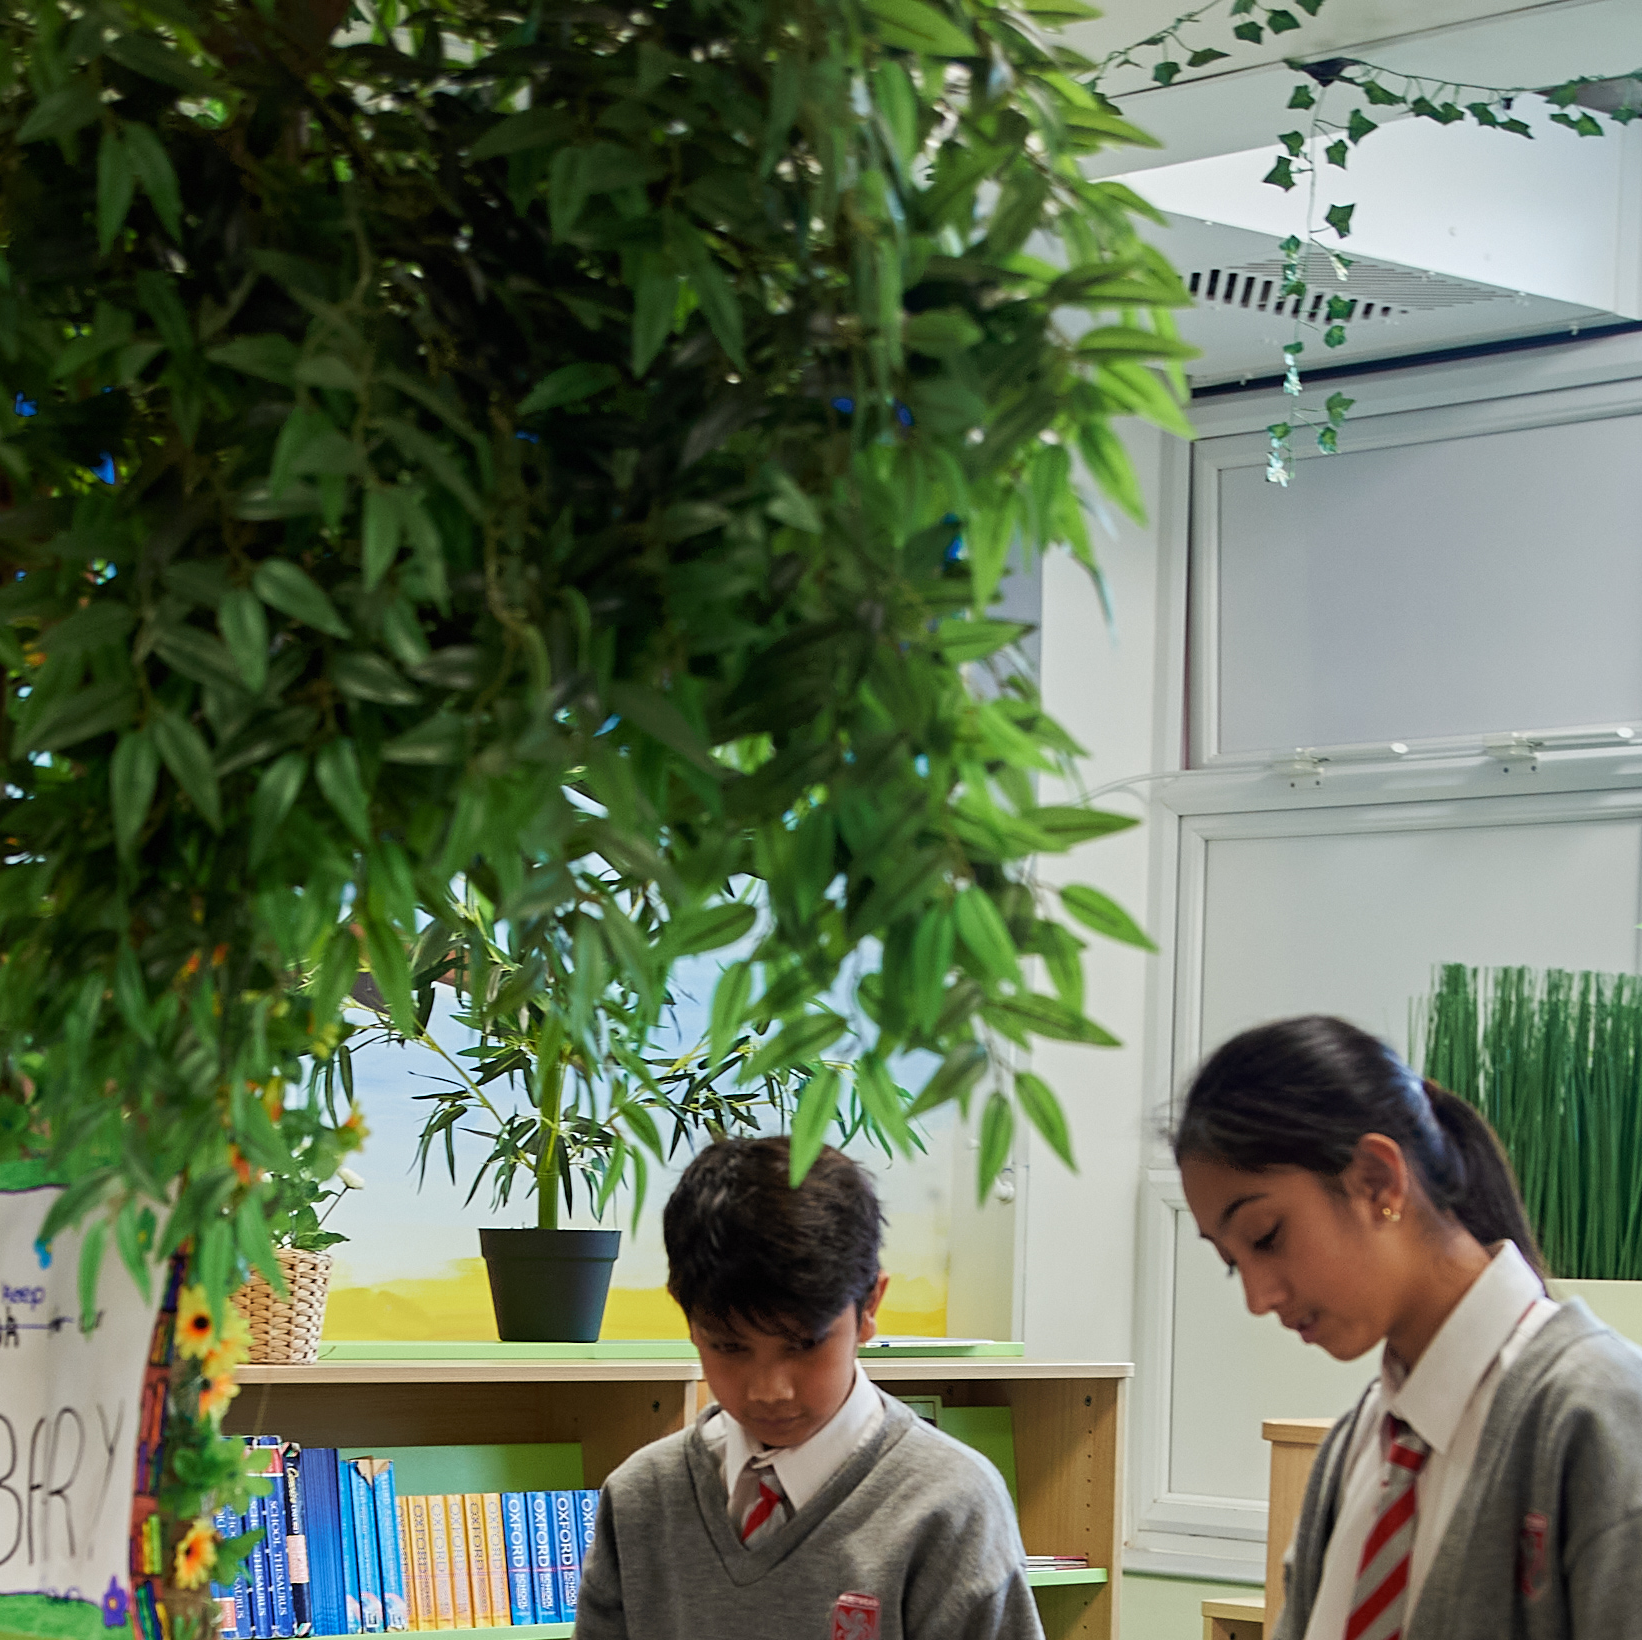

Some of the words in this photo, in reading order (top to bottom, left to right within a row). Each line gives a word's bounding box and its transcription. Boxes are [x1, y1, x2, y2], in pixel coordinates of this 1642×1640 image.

[269, 1500, 281, 1548] SCHOOL
[470, 1502, 485, 1571] OXFORD
[509, 1499, 526, 1568] OXFORD
[533, 1498, 551, 1567] OXFORD
[557, 1497, 574, 1565] OXFORD
[253, 1550, 266, 1617] THESAURUS
[274, 1551, 287, 1616] THESAURUS
